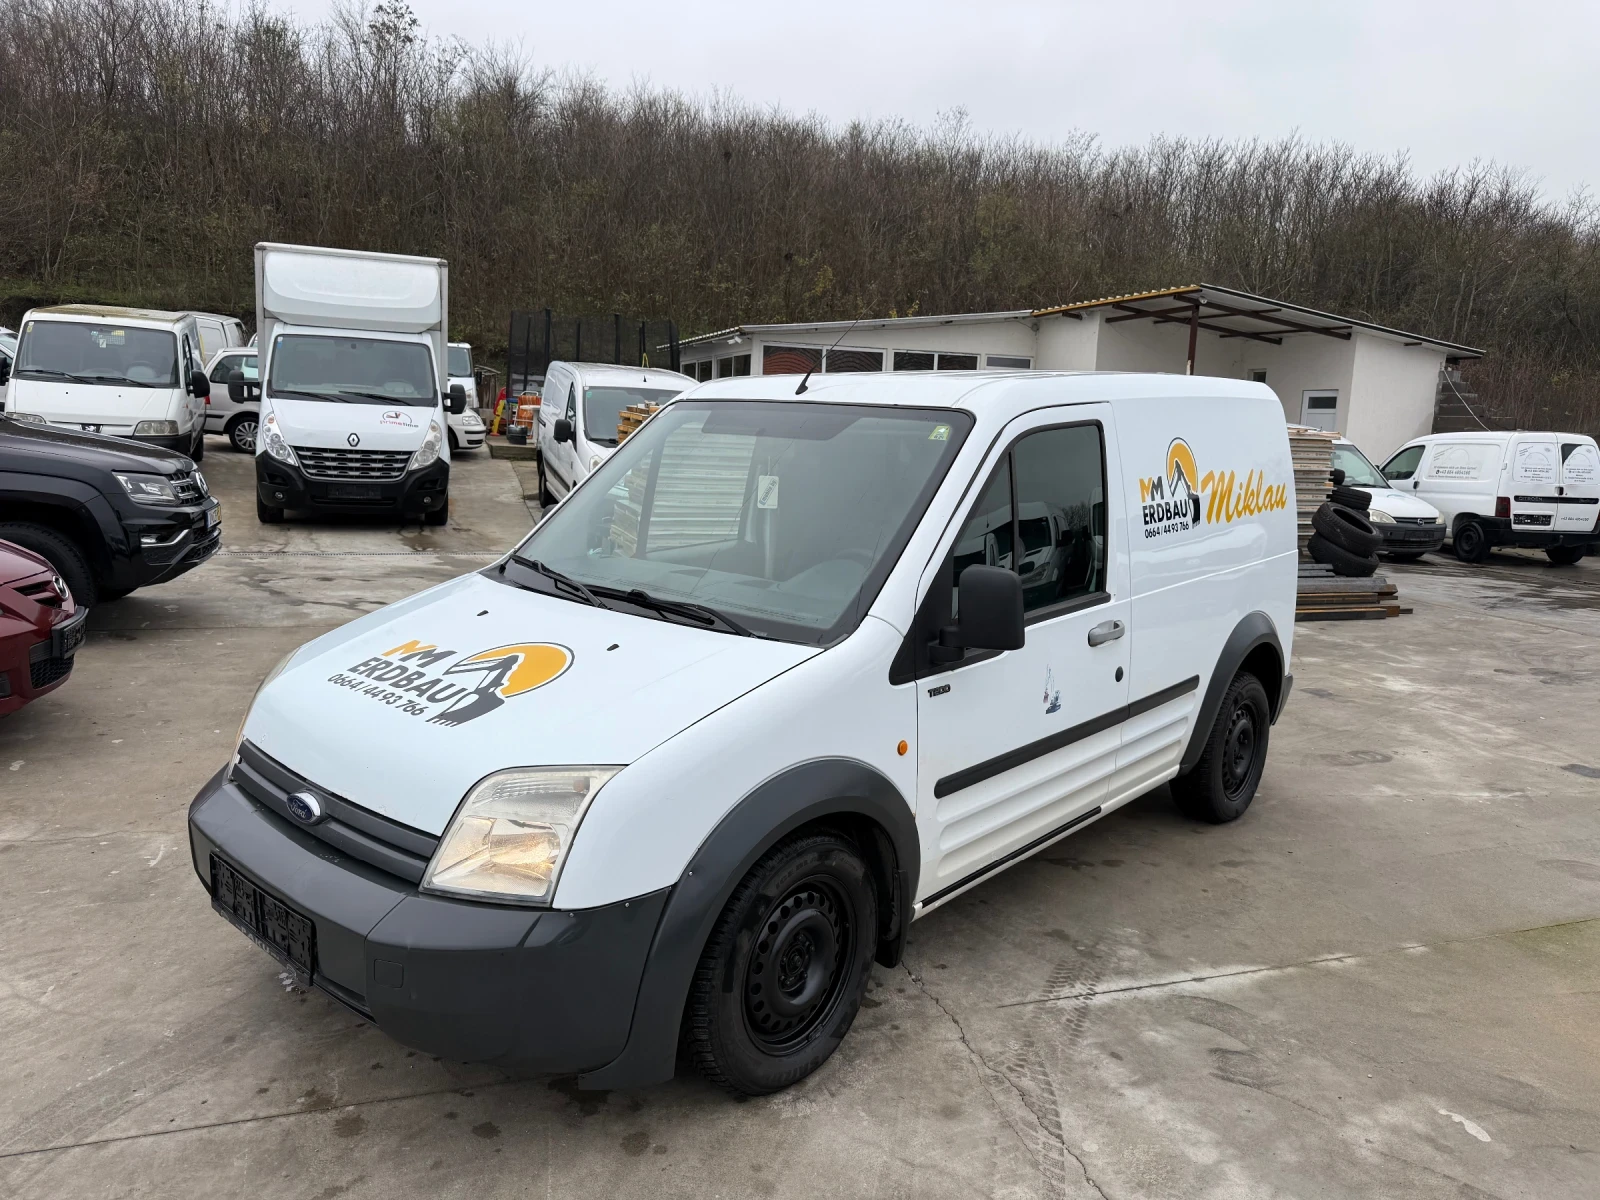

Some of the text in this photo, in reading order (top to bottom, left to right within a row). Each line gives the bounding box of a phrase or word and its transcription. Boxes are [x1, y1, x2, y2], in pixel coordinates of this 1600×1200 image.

[1142, 499, 1188, 525] ERDBAU
[1201, 469, 1287, 524] Miklau
[347, 657, 468, 703] ERDBAU
[290, 799, 308, 818] Ford
